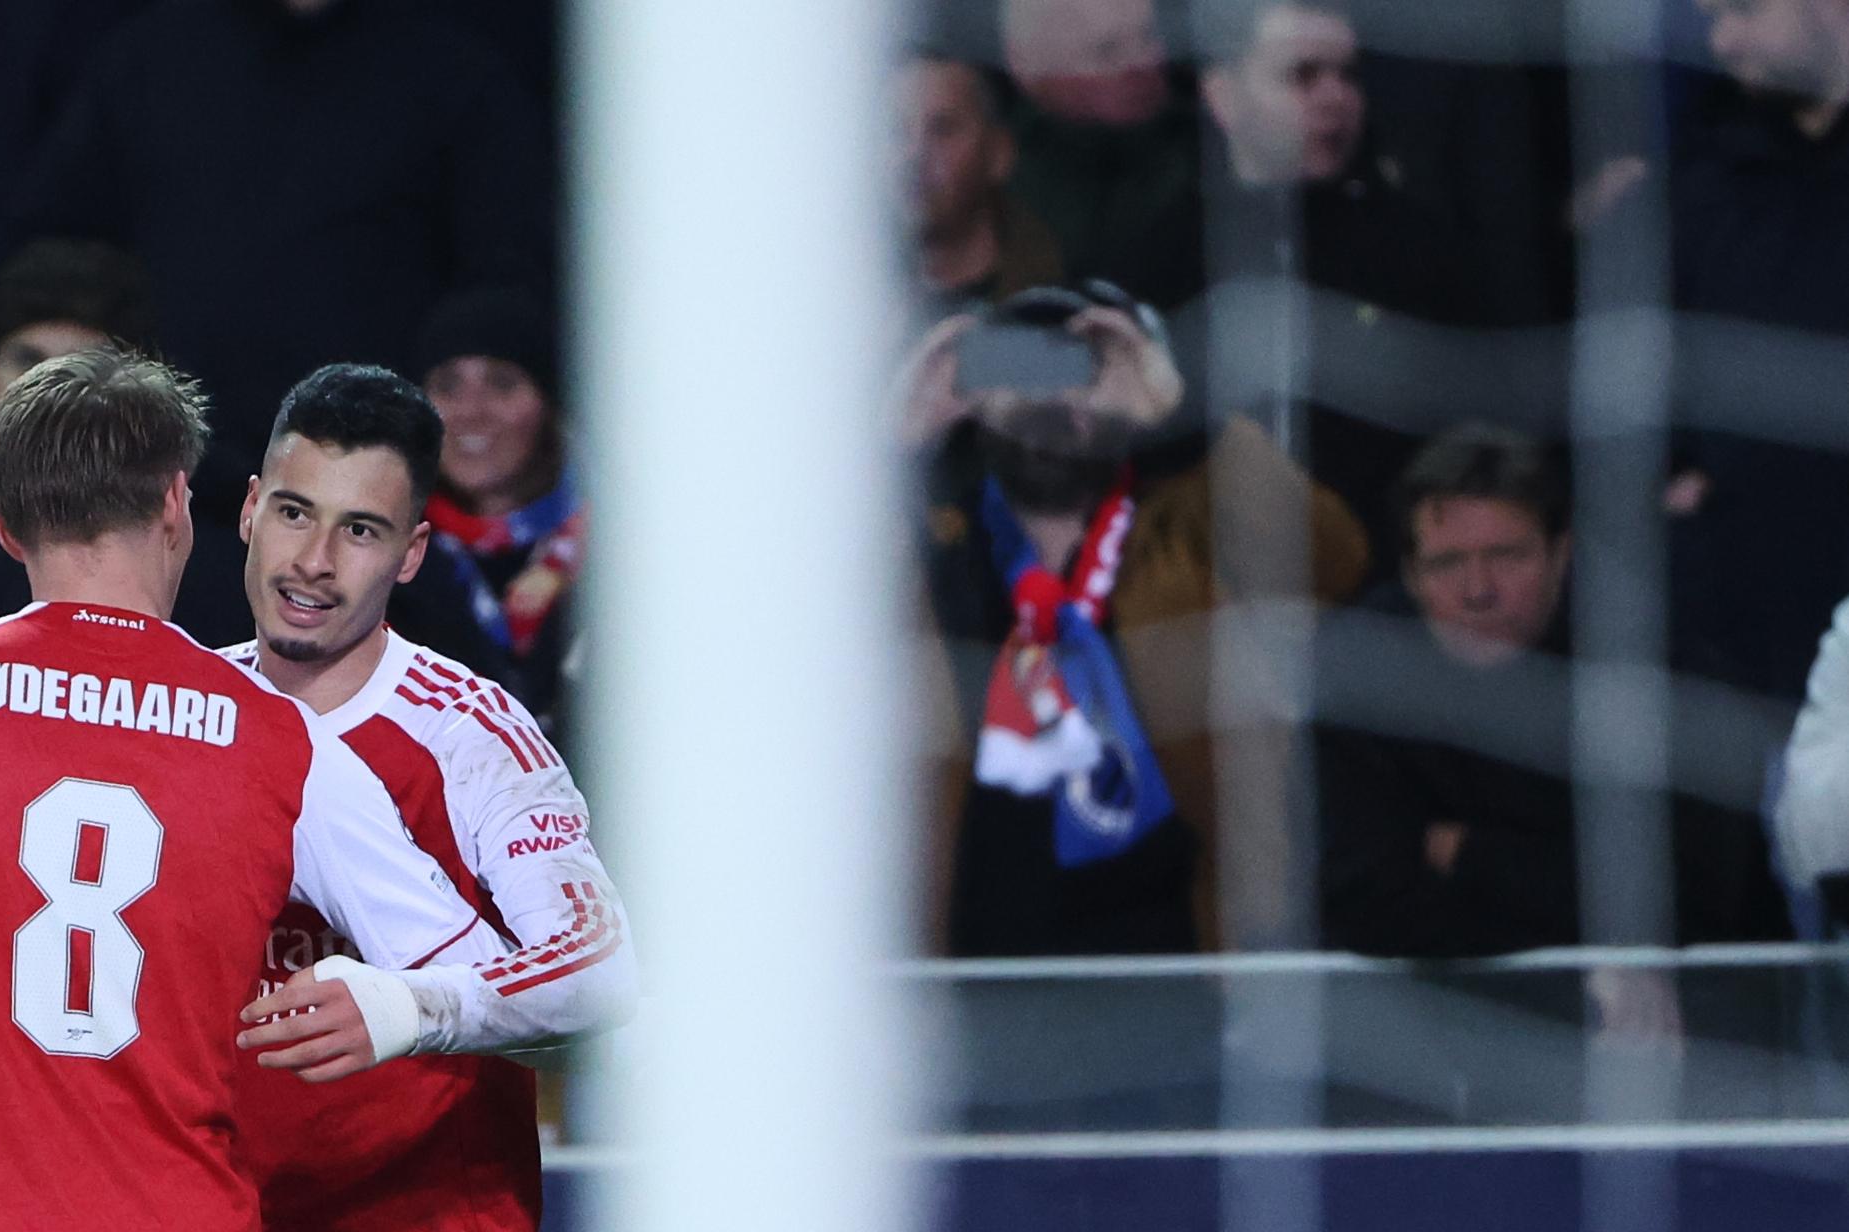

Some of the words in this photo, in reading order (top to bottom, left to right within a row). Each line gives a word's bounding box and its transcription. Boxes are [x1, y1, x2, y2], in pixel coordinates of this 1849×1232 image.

[72, 608, 147, 631] Arsenal
[529, 813, 583, 833] VISI
[11, 776, 166, 1061] 8
